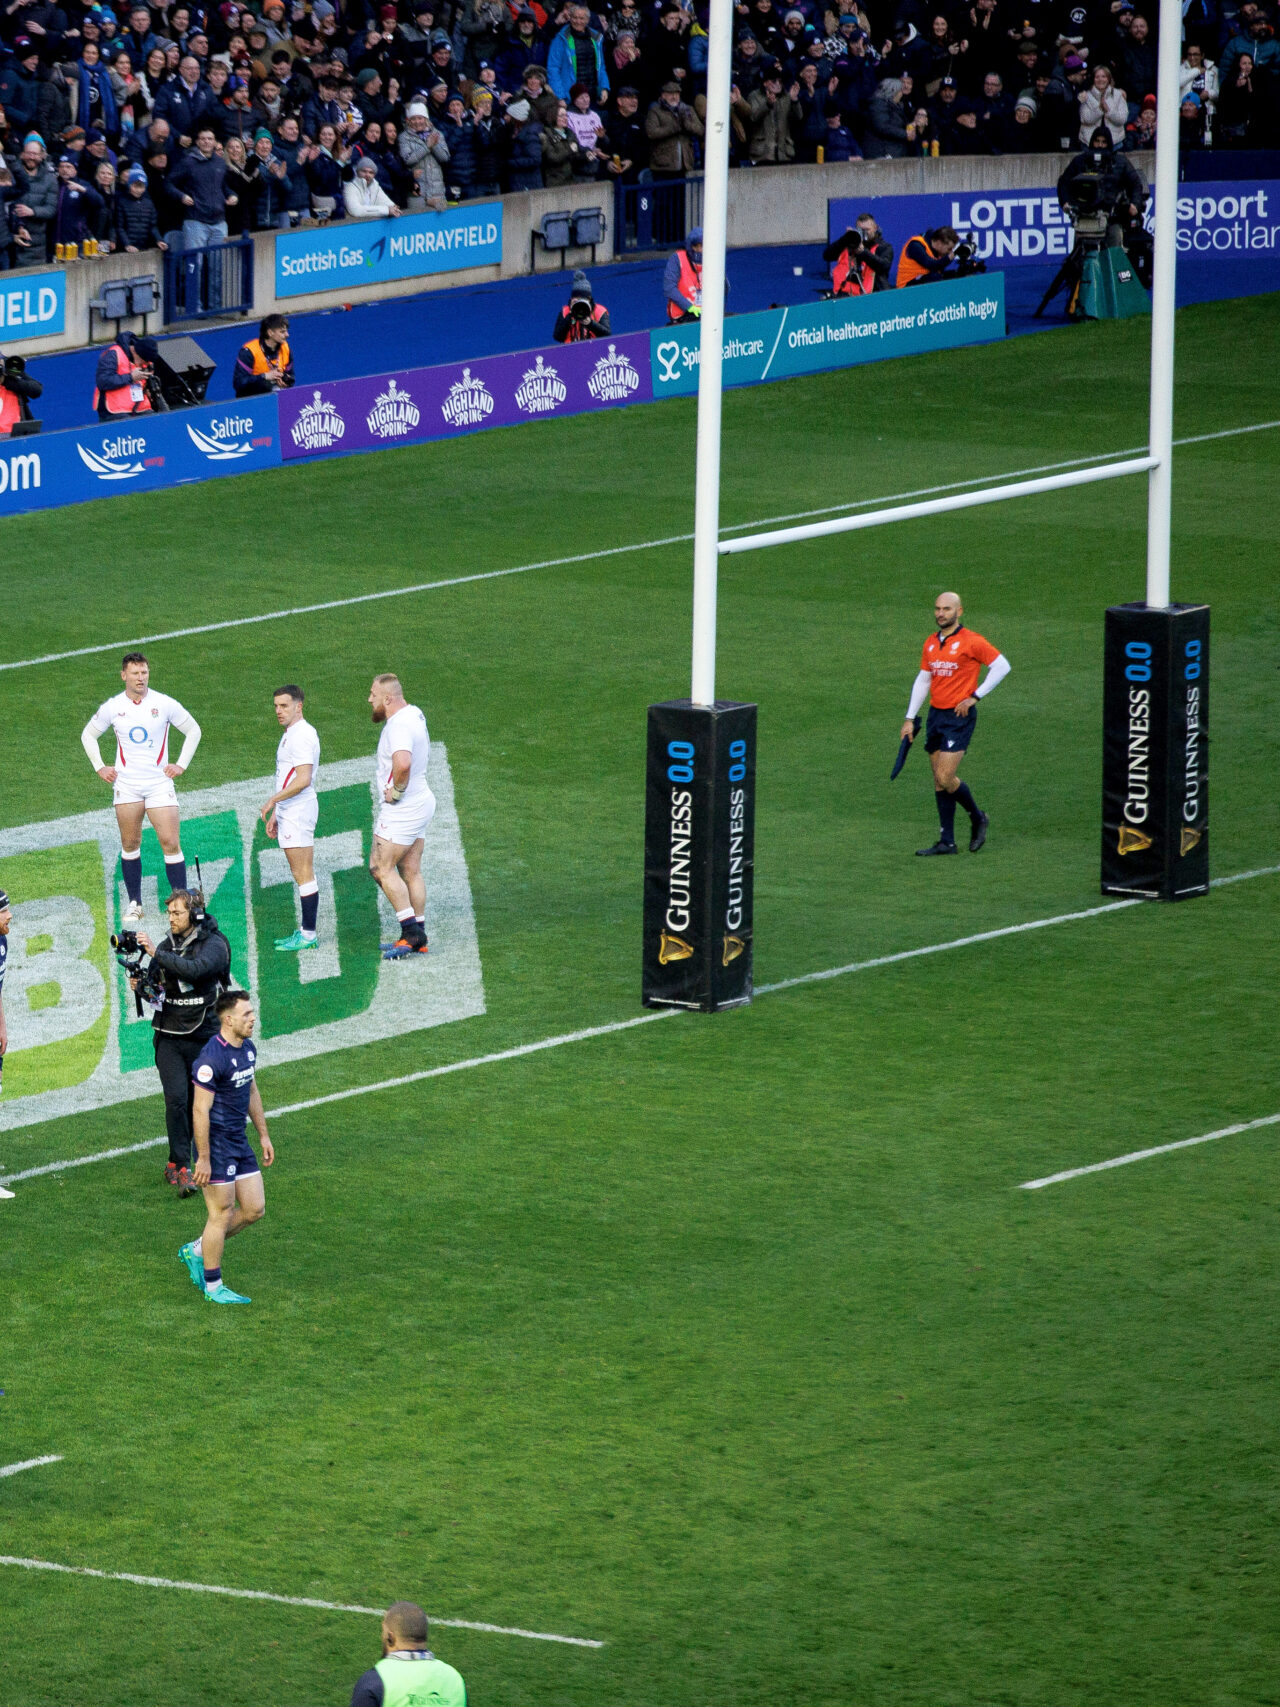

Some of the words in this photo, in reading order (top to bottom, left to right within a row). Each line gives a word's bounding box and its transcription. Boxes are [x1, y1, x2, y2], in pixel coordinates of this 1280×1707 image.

[951, 196, 1071, 229] LOTTE
[1176, 190, 1269, 227] sport
[281, 248, 337, 277] Scottish
[339, 246, 364, 269] Gas
[389, 223, 498, 258] MURRAYFIELD
[953, 227, 1076, 260] UNDE
[788, 325, 824, 349] Official
[826, 321, 878, 342] healthcare
[879, 315, 915, 338] partner
[917, 308, 928, 327] of
[929, 302, 966, 325] Scottish
[968, 297, 998, 320] Rugby
[721, 338, 764, 360] ealthcare
[514, 377, 567, 410] HIGHLAND
[587, 366, 640, 398] HIGHLAND
[600, 385, 629, 402] SPRING
[366, 400, 420, 434] HIGHLAND
[441, 390, 495, 423] HIGHLAND
[454, 409, 483, 427] SPRING
[527, 397, 555, 414] SPRING
[210, 415, 254, 440] Saltire
[290, 412, 346, 445] HIGHLAND
[304, 433, 333, 450] SPRING
[379, 421, 408, 438] SPRING
[102, 434, 146, 460] Saltire
[1124, 641, 1152, 682] 0.0
[1184, 639, 1201, 680] 0.0
[667, 740, 695, 783] 0.0
[728, 739, 747, 782] 0.0
[1123, 688, 1151, 824] GUINNESS
[1183, 686, 1200, 822] GUINNESS
[666, 790, 693, 932] GUINNESS
[726, 788, 744, 931] GUINNESS
[173, 997, 204, 1006] ACCESS
